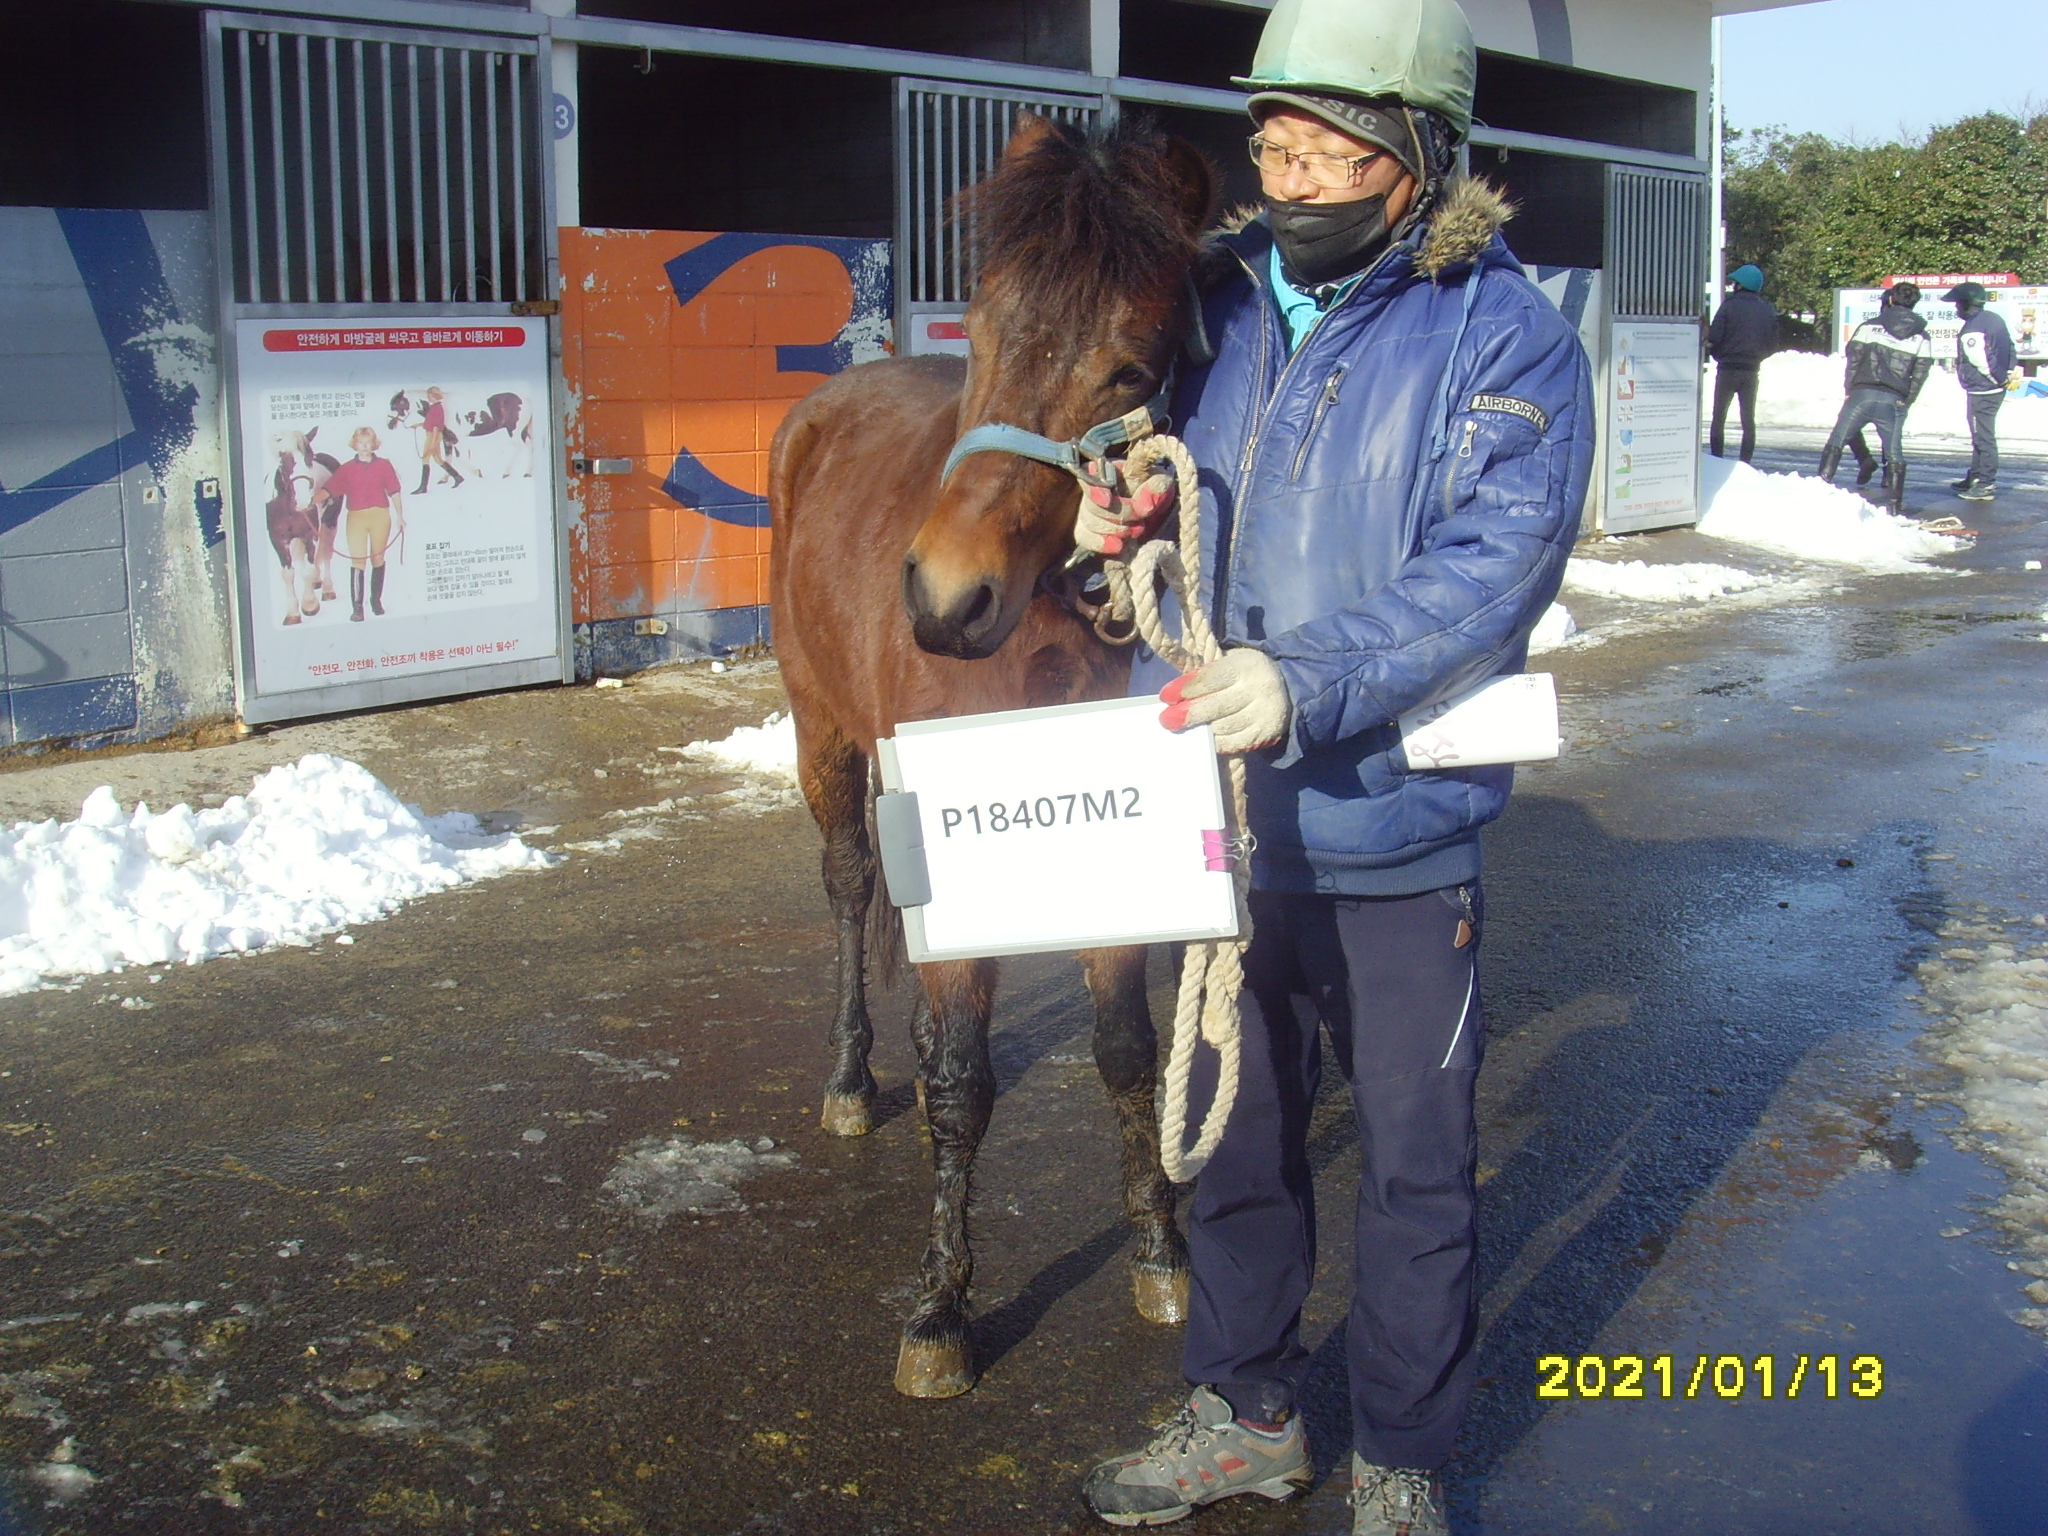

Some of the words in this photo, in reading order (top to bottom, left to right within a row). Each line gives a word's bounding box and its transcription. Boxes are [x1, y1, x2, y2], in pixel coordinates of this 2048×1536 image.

[1917, 276, 1940, 285] 안전은
[297, 333, 340, 346] 안전하게
[343, 332, 385, 345] 마방굴레
[388, 332, 419, 344] 씌우고
[422, 331, 462, 344] 올바르게
[464, 330, 503, 343] 이동하기
[1477, 397, 1547, 427] AIRBORNE
[381, 653, 416, 668] 안전조끼
[420, 649, 445, 662] 착용은
[448, 645, 473, 658] 선택이
[476, 643, 493, 654] 아닌
[941, 787, 1143, 837] P18407M2
